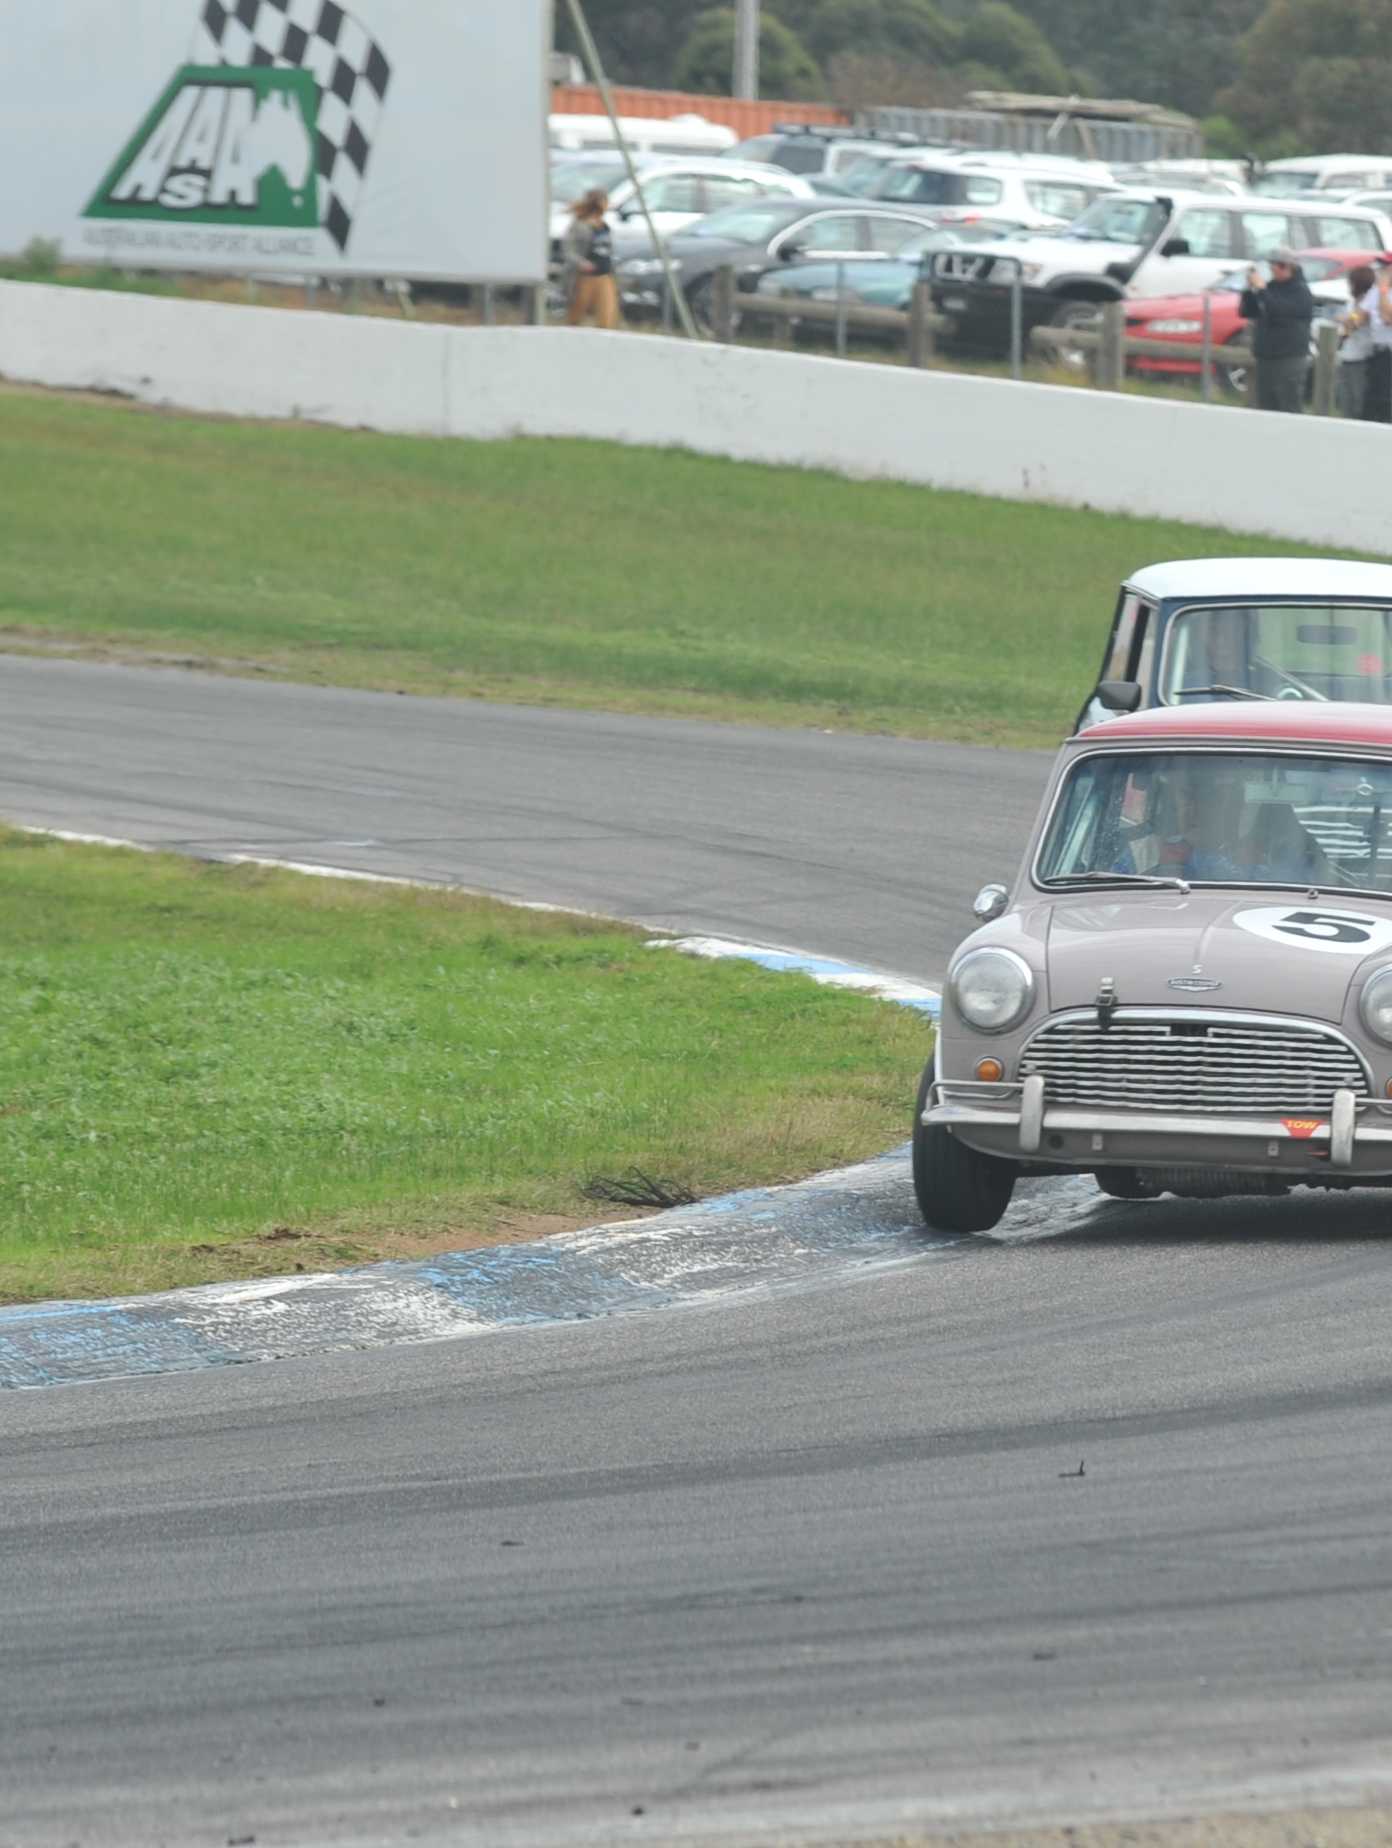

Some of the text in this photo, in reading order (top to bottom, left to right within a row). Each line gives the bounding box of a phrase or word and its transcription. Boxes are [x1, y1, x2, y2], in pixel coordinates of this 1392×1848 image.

[1271, 911, 1377, 943] 5
[1192, 964, 1203, 974] S
[1286, 1120, 1318, 1129] TOW
